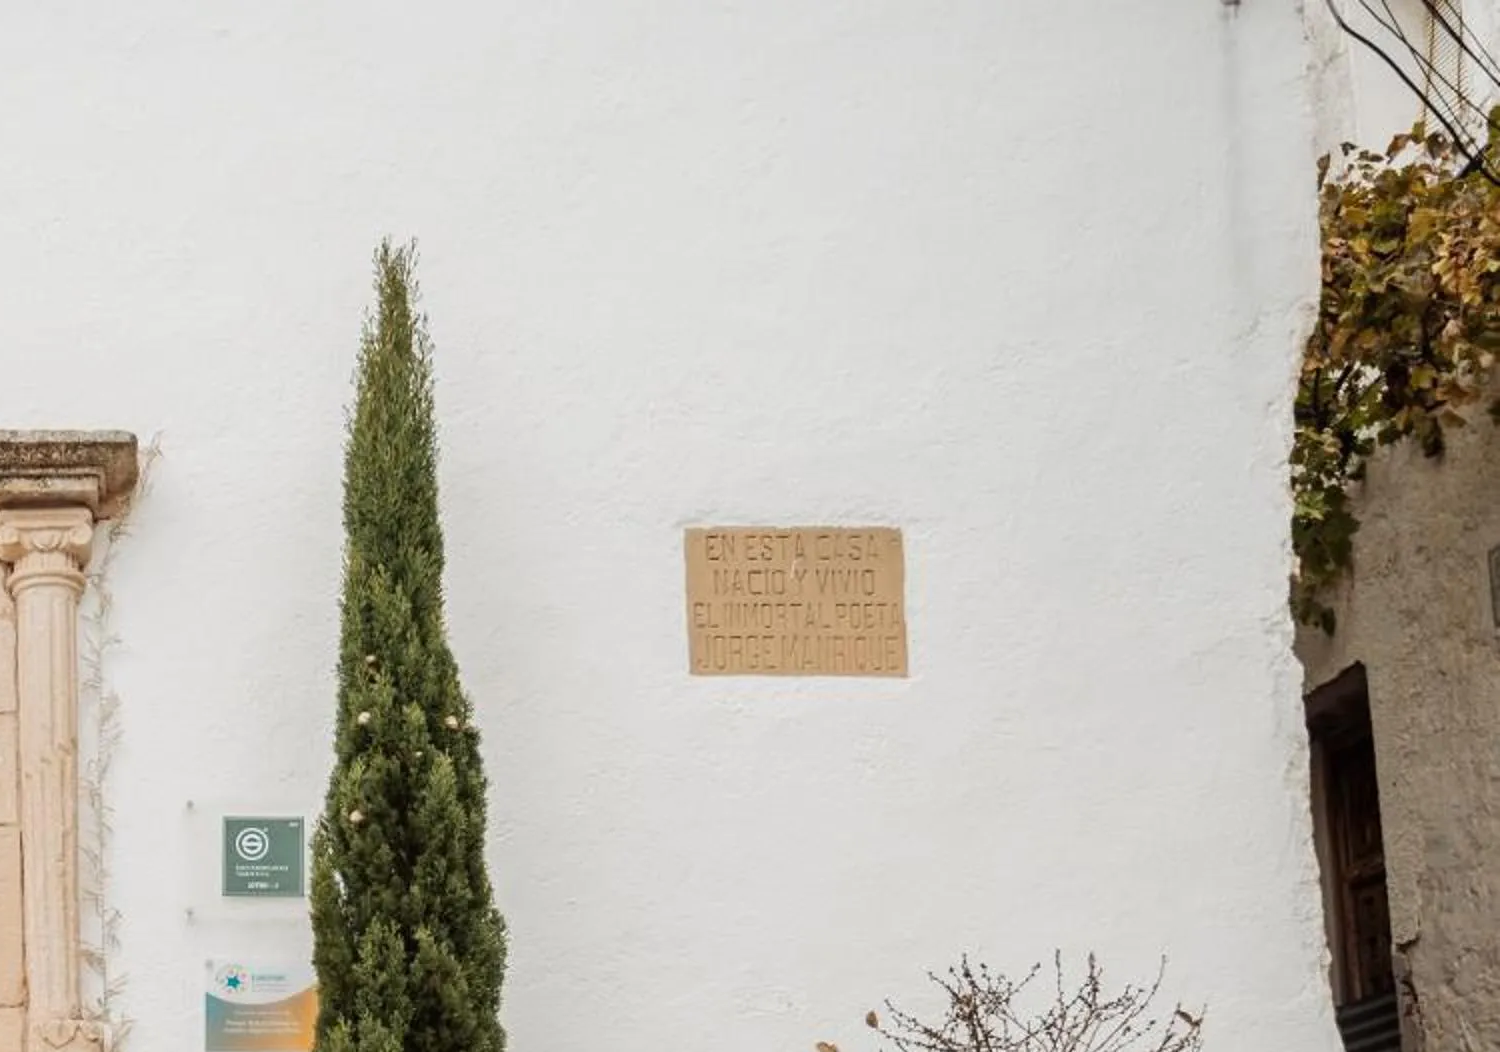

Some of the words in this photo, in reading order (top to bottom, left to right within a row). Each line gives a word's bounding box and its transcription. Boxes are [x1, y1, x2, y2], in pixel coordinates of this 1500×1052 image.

[706, 534, 736, 561] EN
[745, 534, 806, 561] ESTA
[815, 534, 881, 561] CASA
[713, 568, 786, 596] NACIO
[815, 568, 876, 596] VIVIO
[696, 634, 777, 670] JORGE
